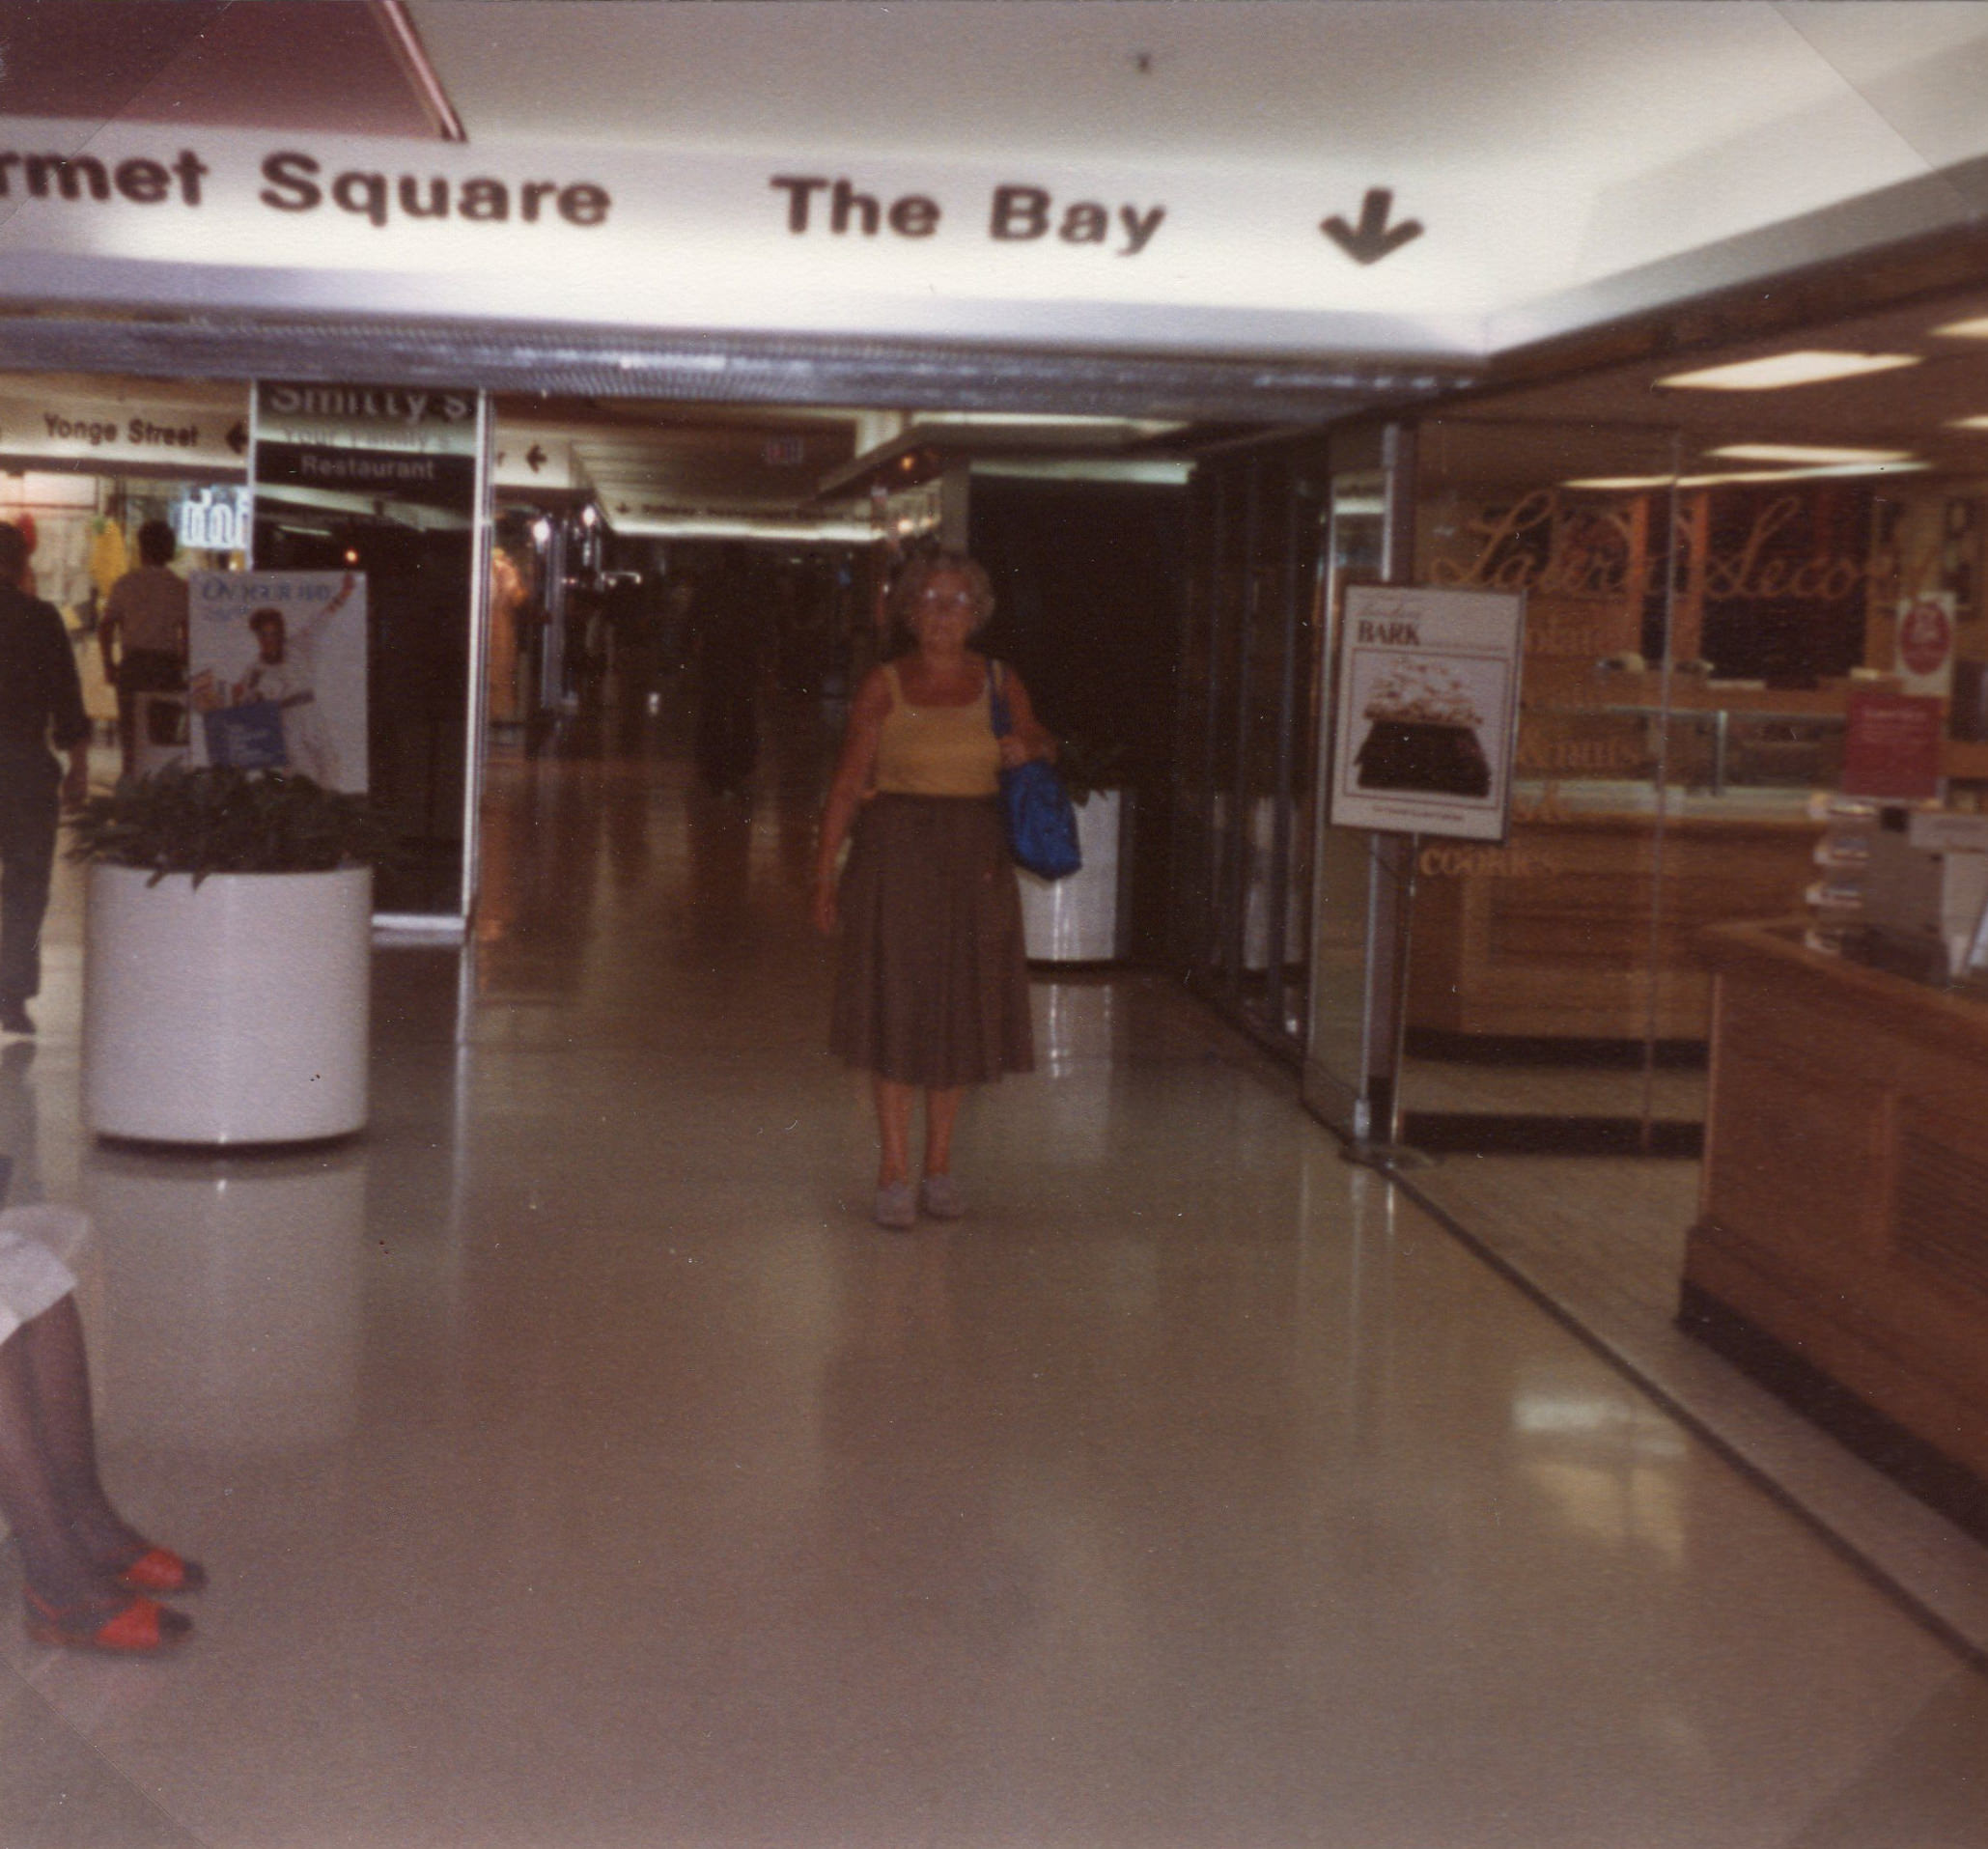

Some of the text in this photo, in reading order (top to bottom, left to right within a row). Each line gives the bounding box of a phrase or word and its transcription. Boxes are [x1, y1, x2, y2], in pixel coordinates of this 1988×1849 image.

[259, 151, 612, 227] Square
[770, 175, 941, 238] The
[989, 184, 1165, 257] Bay
[270, 390, 470, 425] Smittys
[43, 412, 199, 449] Yonge Street
[299, 454, 436, 481] Restaurant
[1358, 620, 1420, 647] BARK
